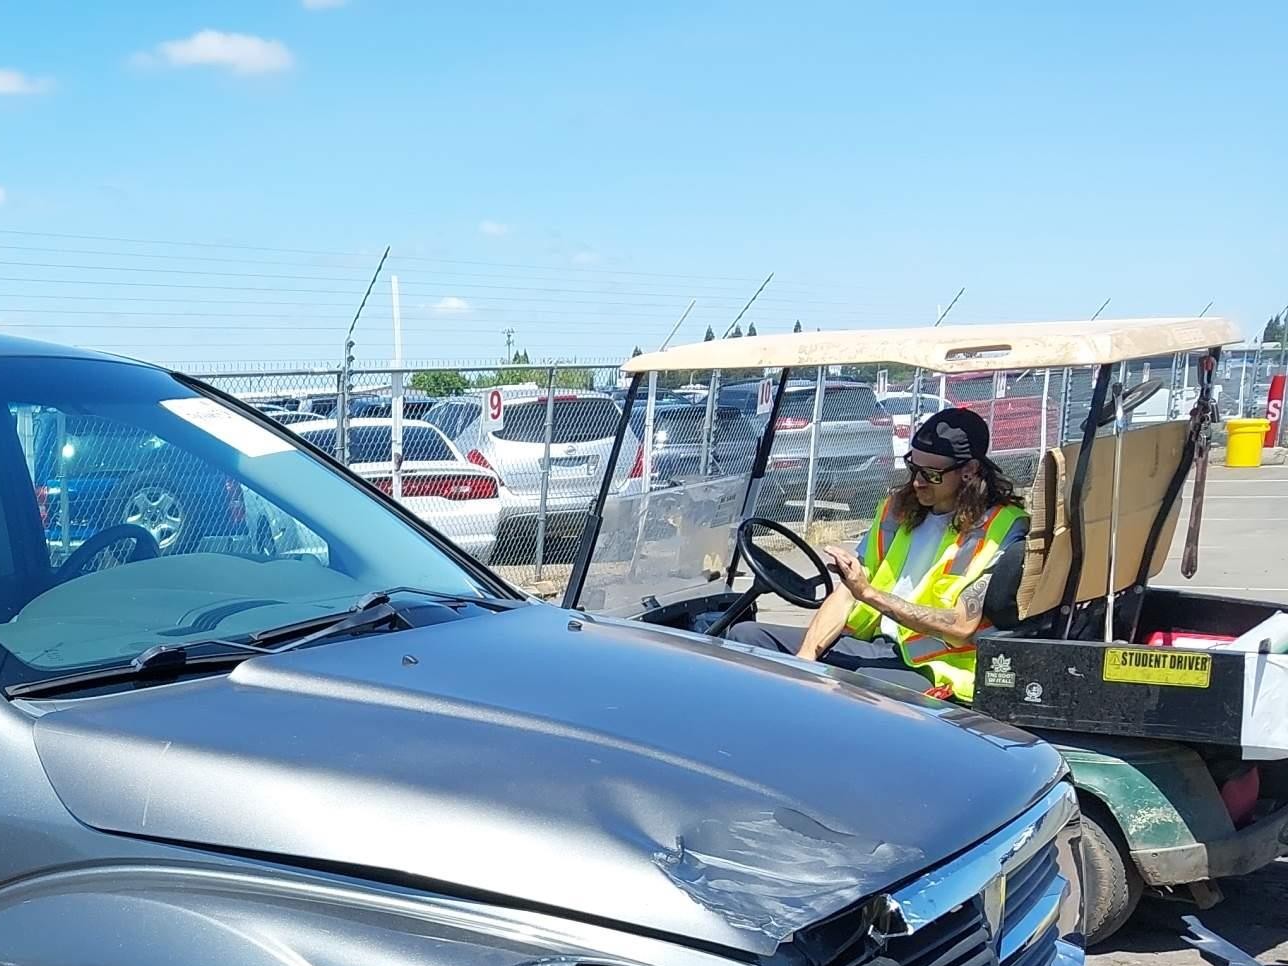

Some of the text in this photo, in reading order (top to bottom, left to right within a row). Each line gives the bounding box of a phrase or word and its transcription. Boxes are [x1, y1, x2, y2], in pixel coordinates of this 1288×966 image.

[490, 390, 502, 420] 9
[1267, 400, 1281, 422] S
[1121, 651, 1208, 671] STUDENT DRIVER
